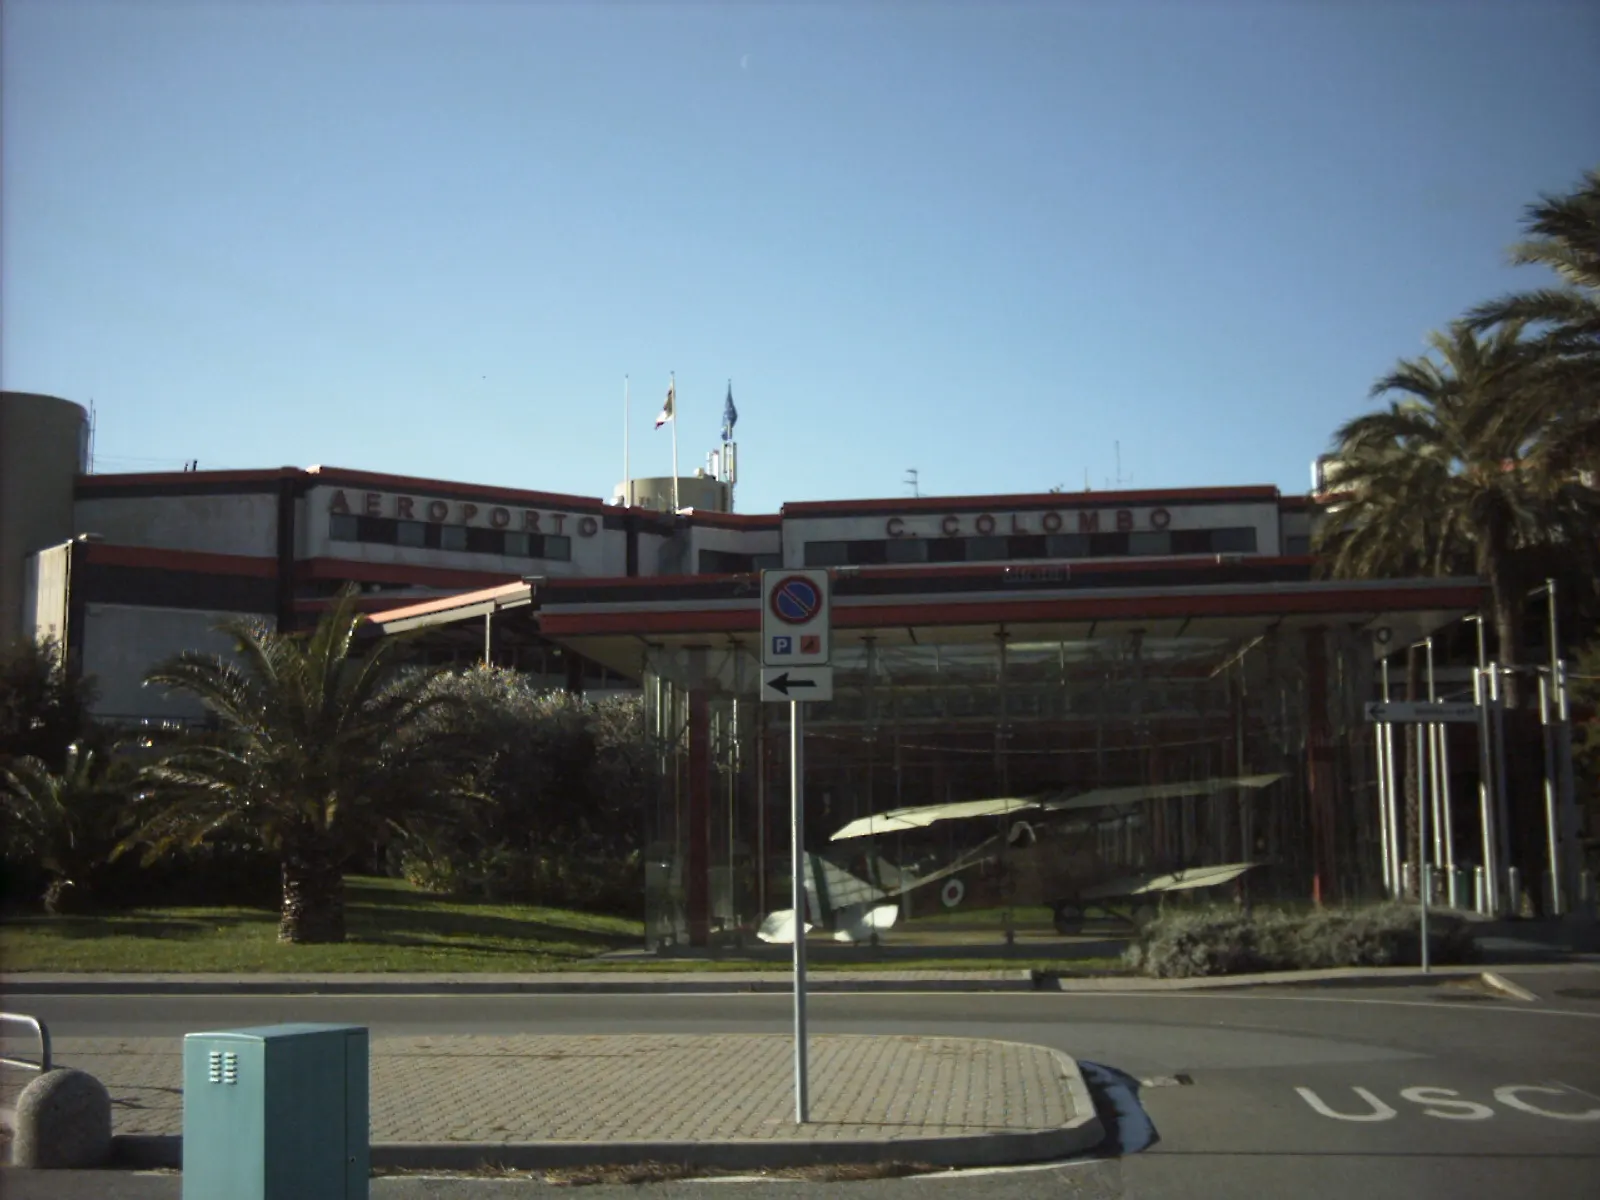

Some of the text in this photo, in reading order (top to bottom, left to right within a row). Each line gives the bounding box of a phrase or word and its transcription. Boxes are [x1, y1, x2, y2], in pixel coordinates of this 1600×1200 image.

[328, 488, 598, 538] AEROPORTO
[885, 507, 1172, 538] C. COLOMBO
[776, 638, 788, 652] P
